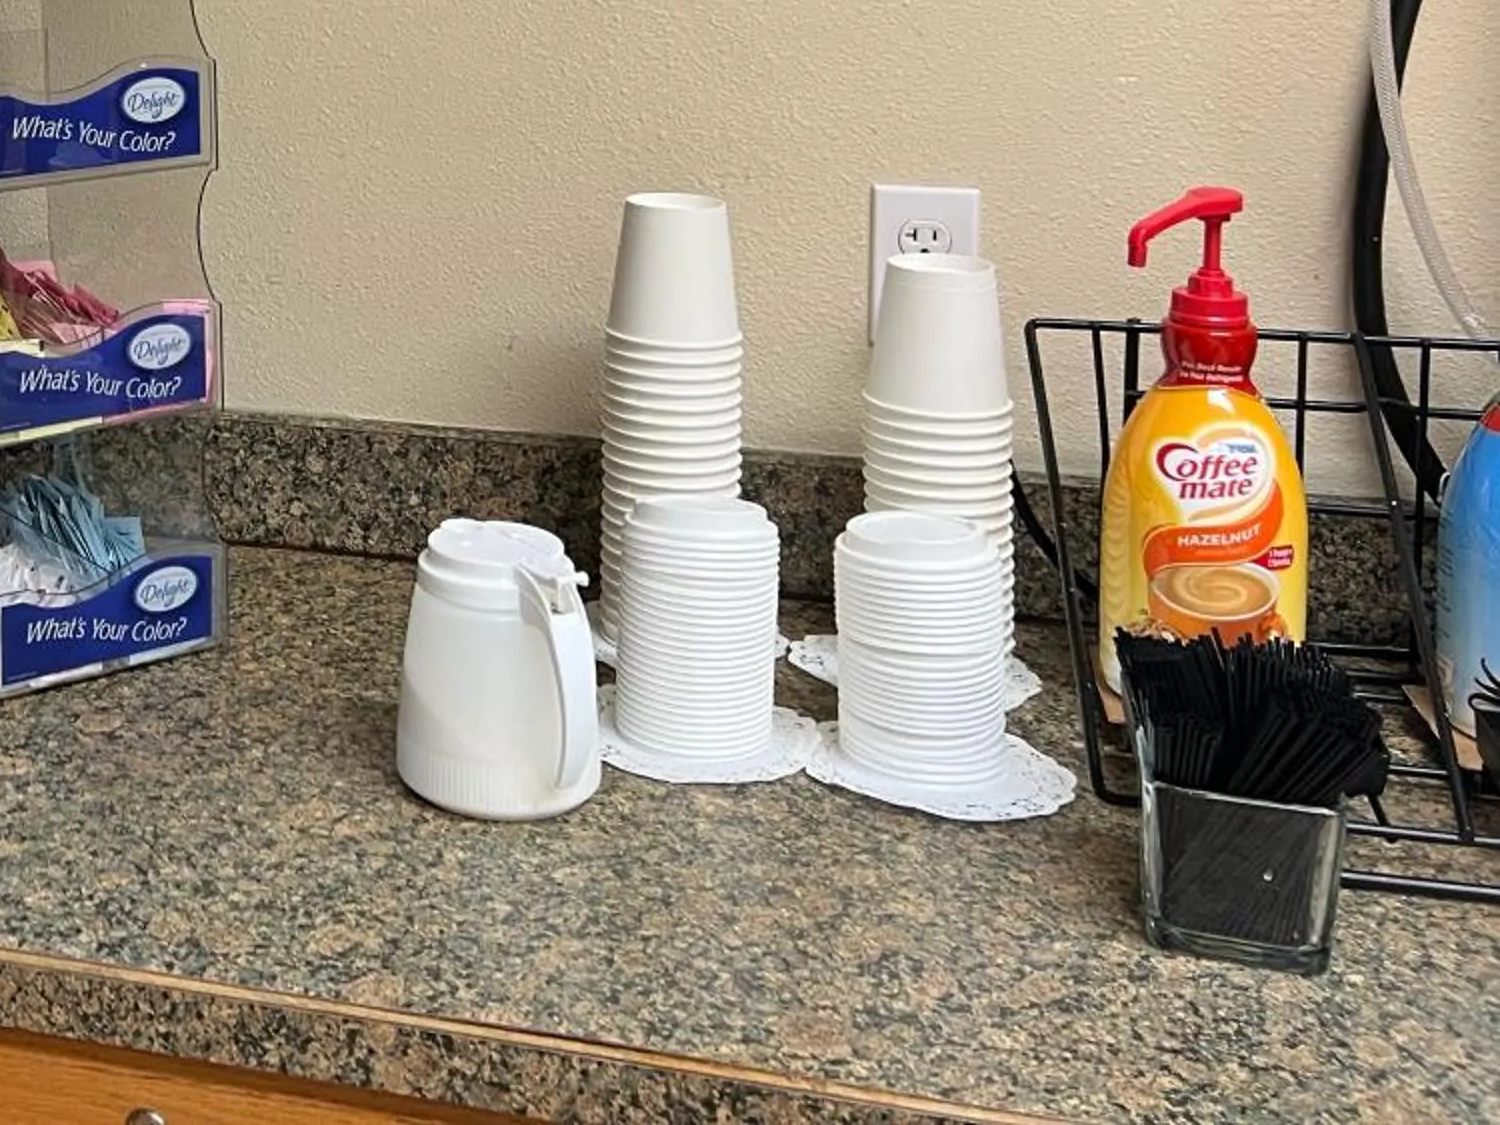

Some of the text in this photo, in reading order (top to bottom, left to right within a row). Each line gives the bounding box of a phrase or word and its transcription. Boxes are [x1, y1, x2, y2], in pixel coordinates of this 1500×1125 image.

[127, 90, 180, 119] Delight
[11, 115, 177, 153] What's Your Color?
[133, 336, 185, 365] Delight
[19, 365, 182, 400] What's Your Color?
[1155, 442, 1258, 482] Coffee
[1179, 478, 1253, 500] mate
[1177, 522, 1261, 547] HAZELNUT
[140, 577, 190, 606] Delight
[26, 615, 188, 644] What's Your Color?
